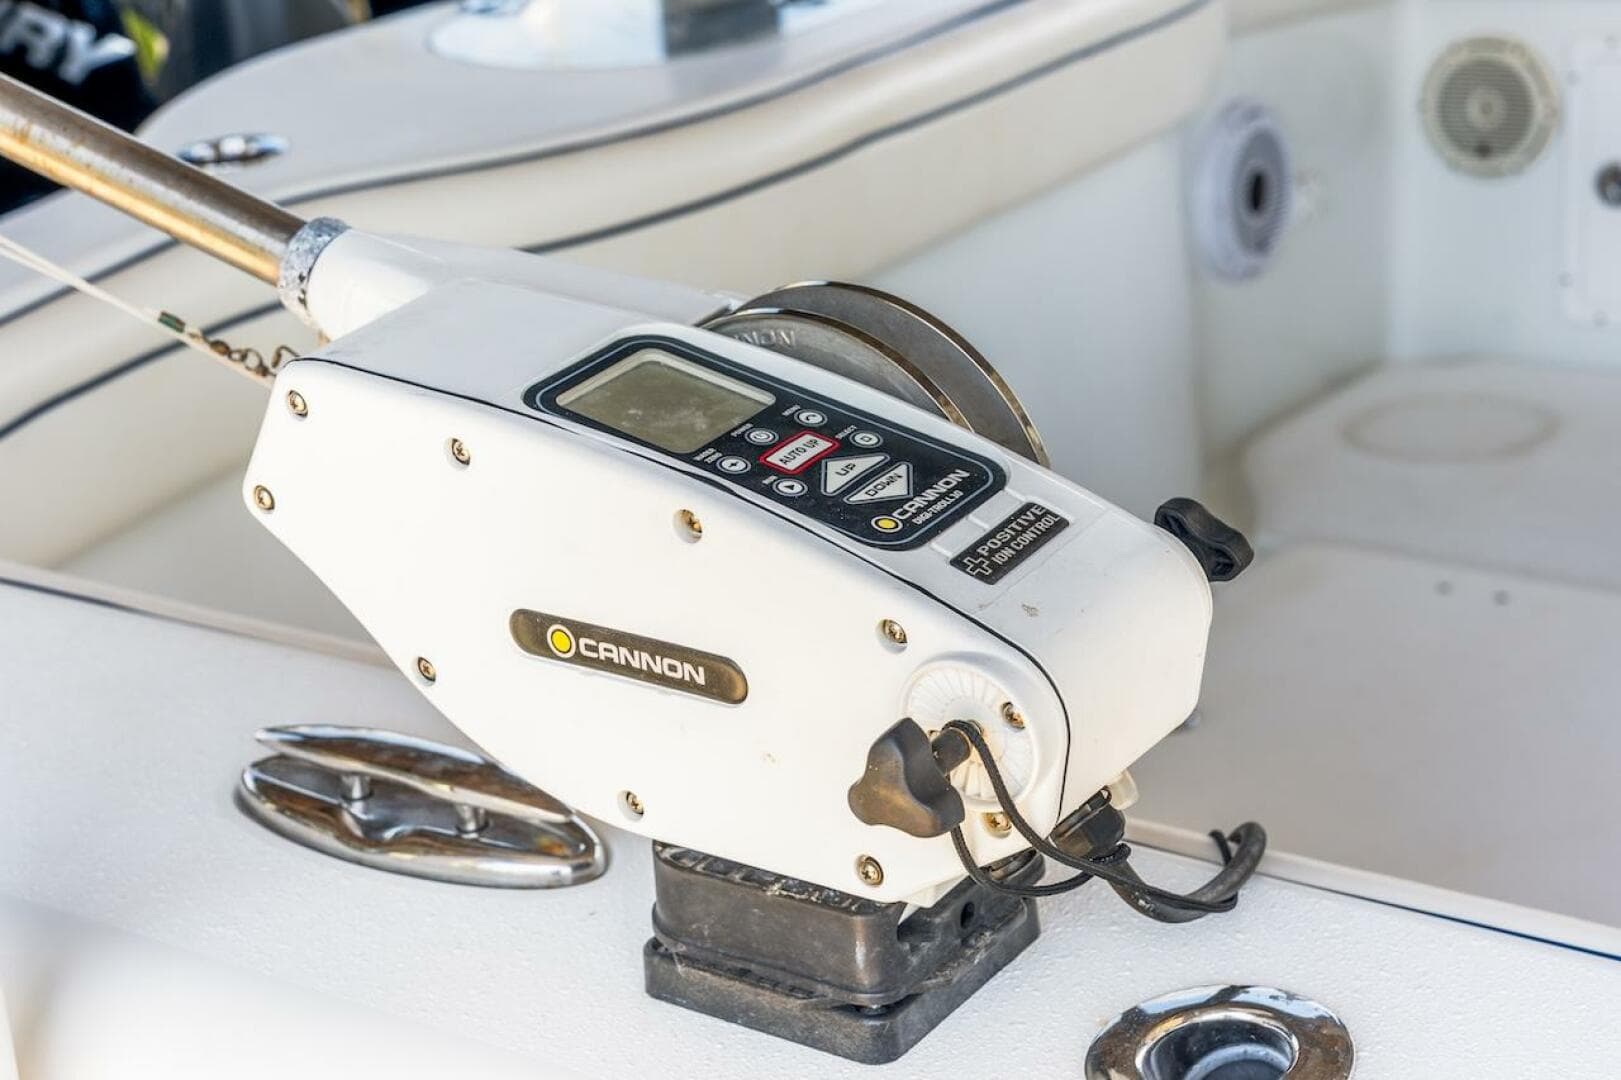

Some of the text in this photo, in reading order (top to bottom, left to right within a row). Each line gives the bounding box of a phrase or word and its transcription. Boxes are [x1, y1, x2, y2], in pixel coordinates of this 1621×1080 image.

[0, 1, 136, 85] RY
[779, 438, 820, 466] AUTO UP
[835, 462, 856, 477] UP
[865, 472, 903, 497] DOWN
[892, 469, 971, 520] CANNON
[976, 503, 1047, 557] POSITIVE
[991, 513, 1060, 566] ION CONTROL
[578, 637, 706, 685] CANNON
